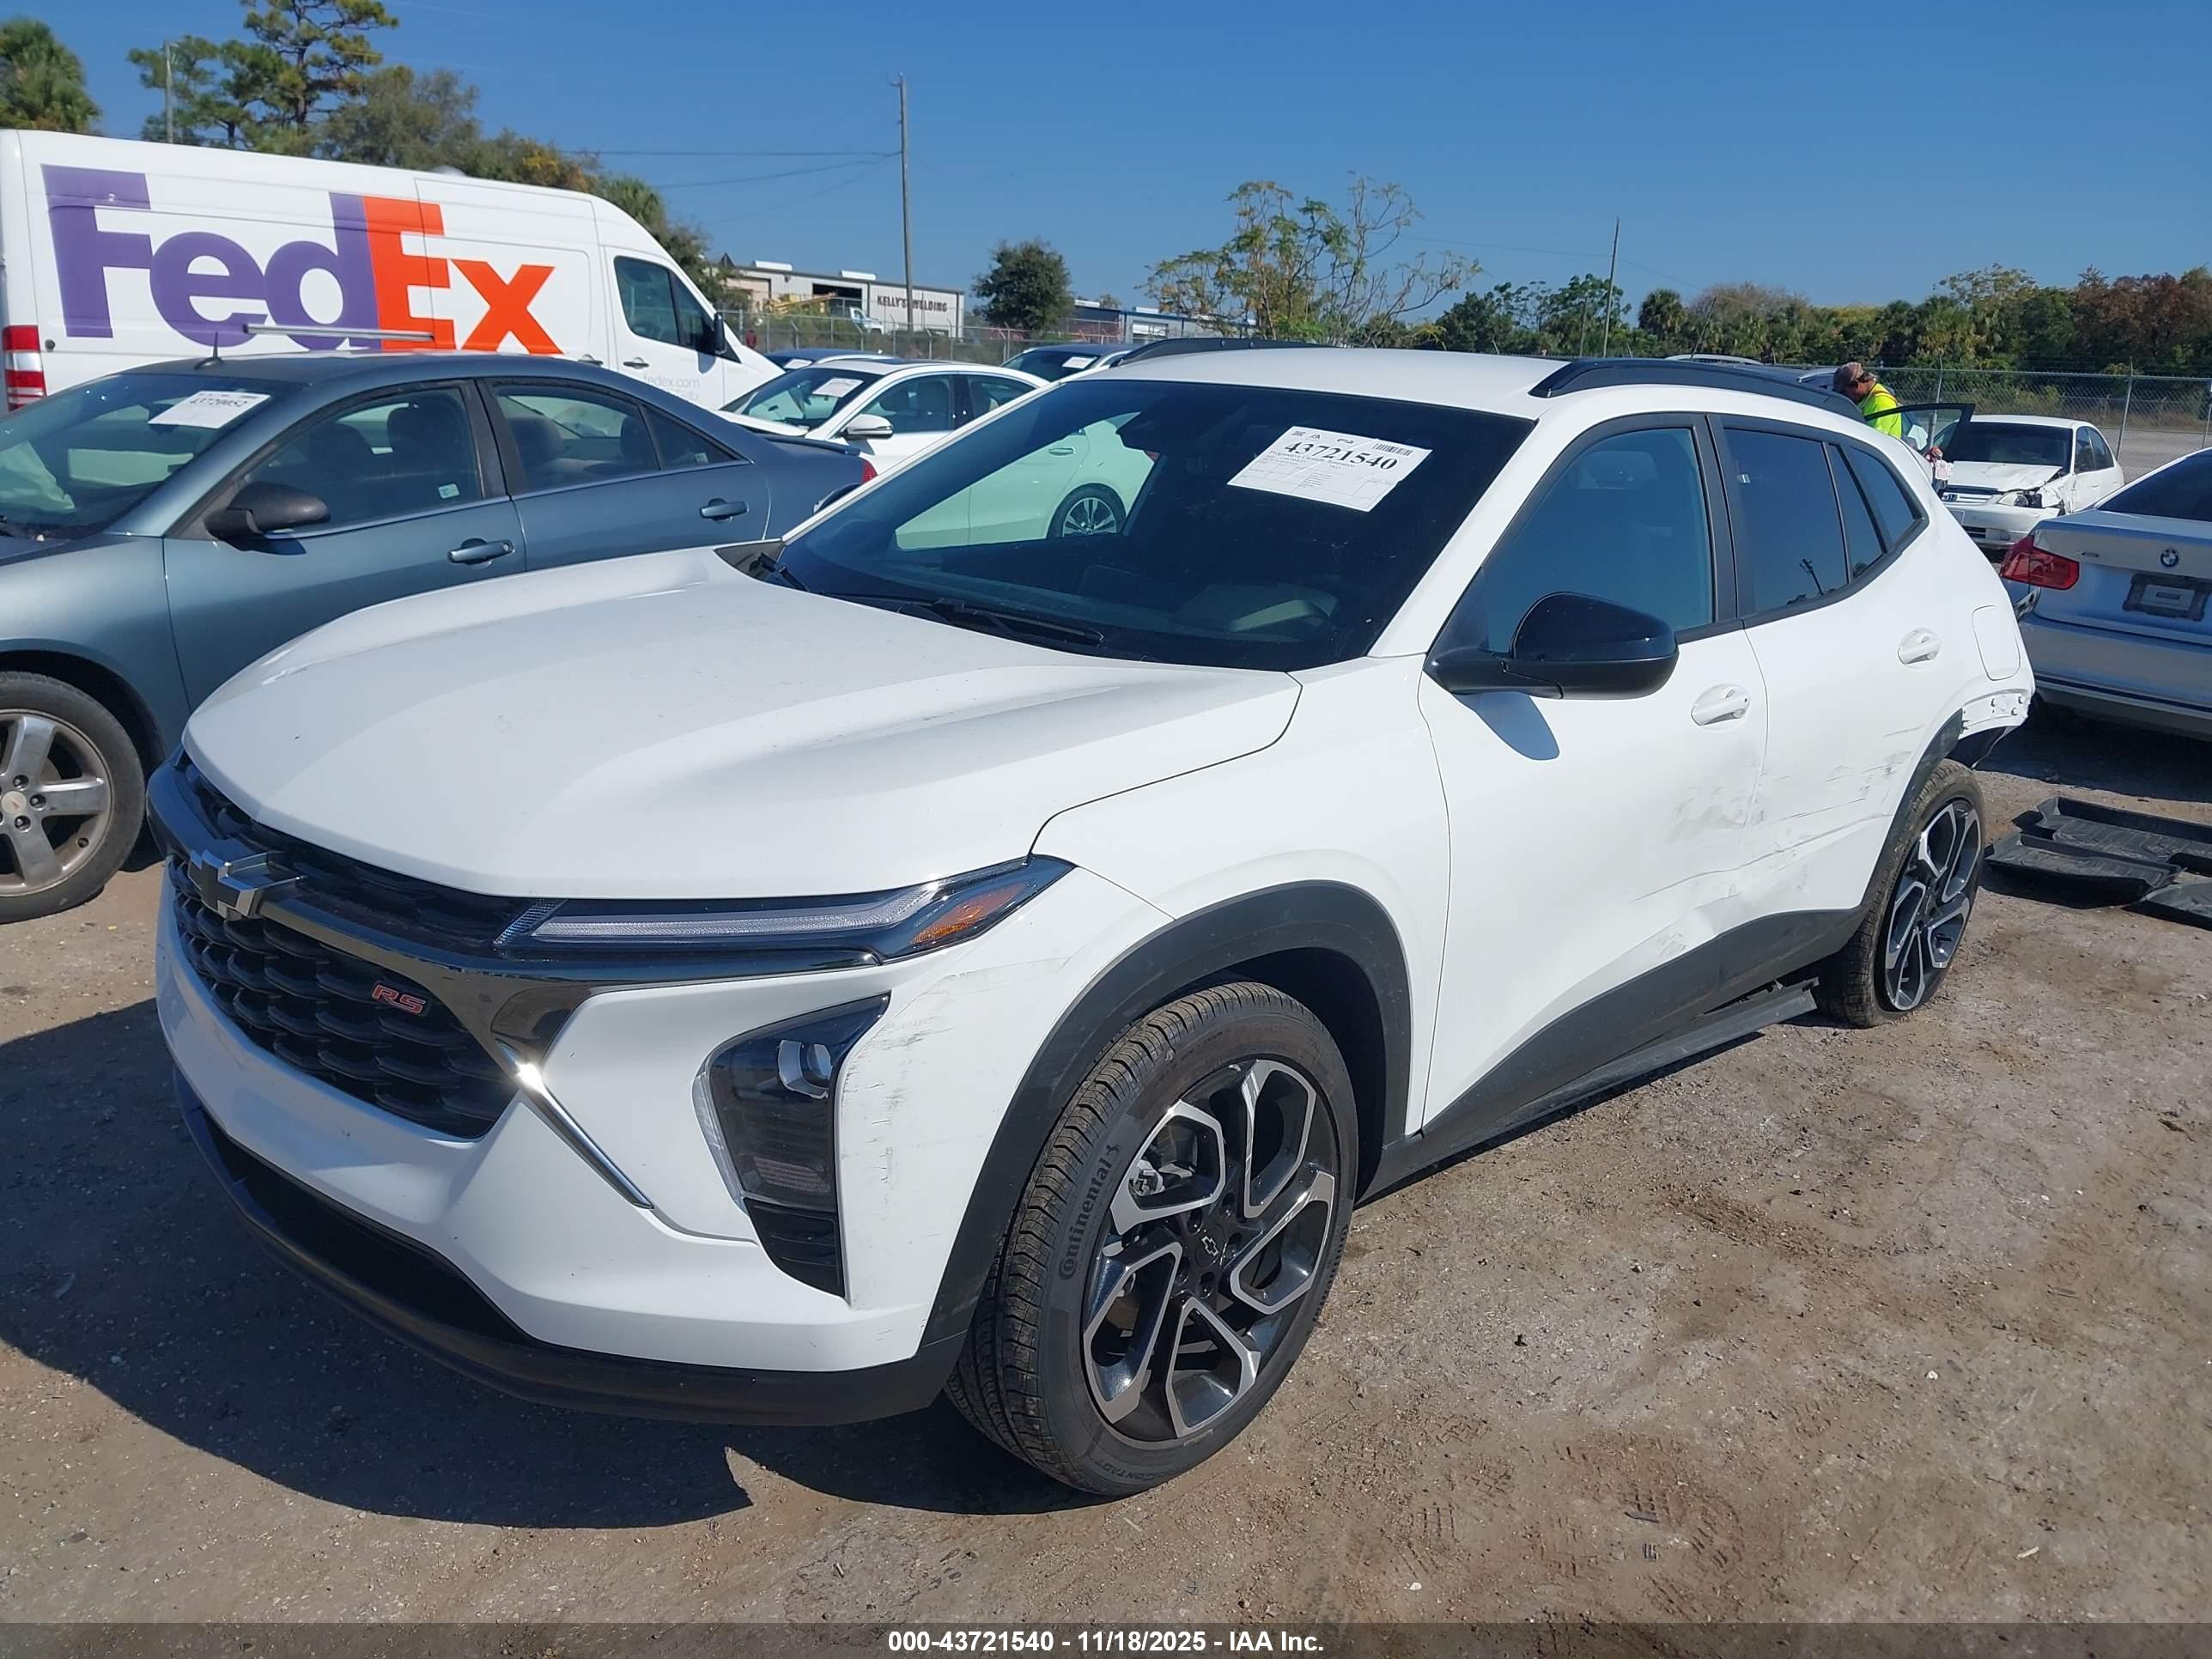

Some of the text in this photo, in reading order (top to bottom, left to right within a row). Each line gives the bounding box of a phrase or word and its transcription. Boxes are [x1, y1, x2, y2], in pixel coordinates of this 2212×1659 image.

[41, 164, 563, 355] FedEx
[878, 295, 948, 313] KELLY'S WELDING
[644, 373, 700, 390] fedex.com
[1284, 441, 1398, 471] 43721540
[371, 984, 427, 1014] RS
[1058, 1157, 1114, 1280] Continental
